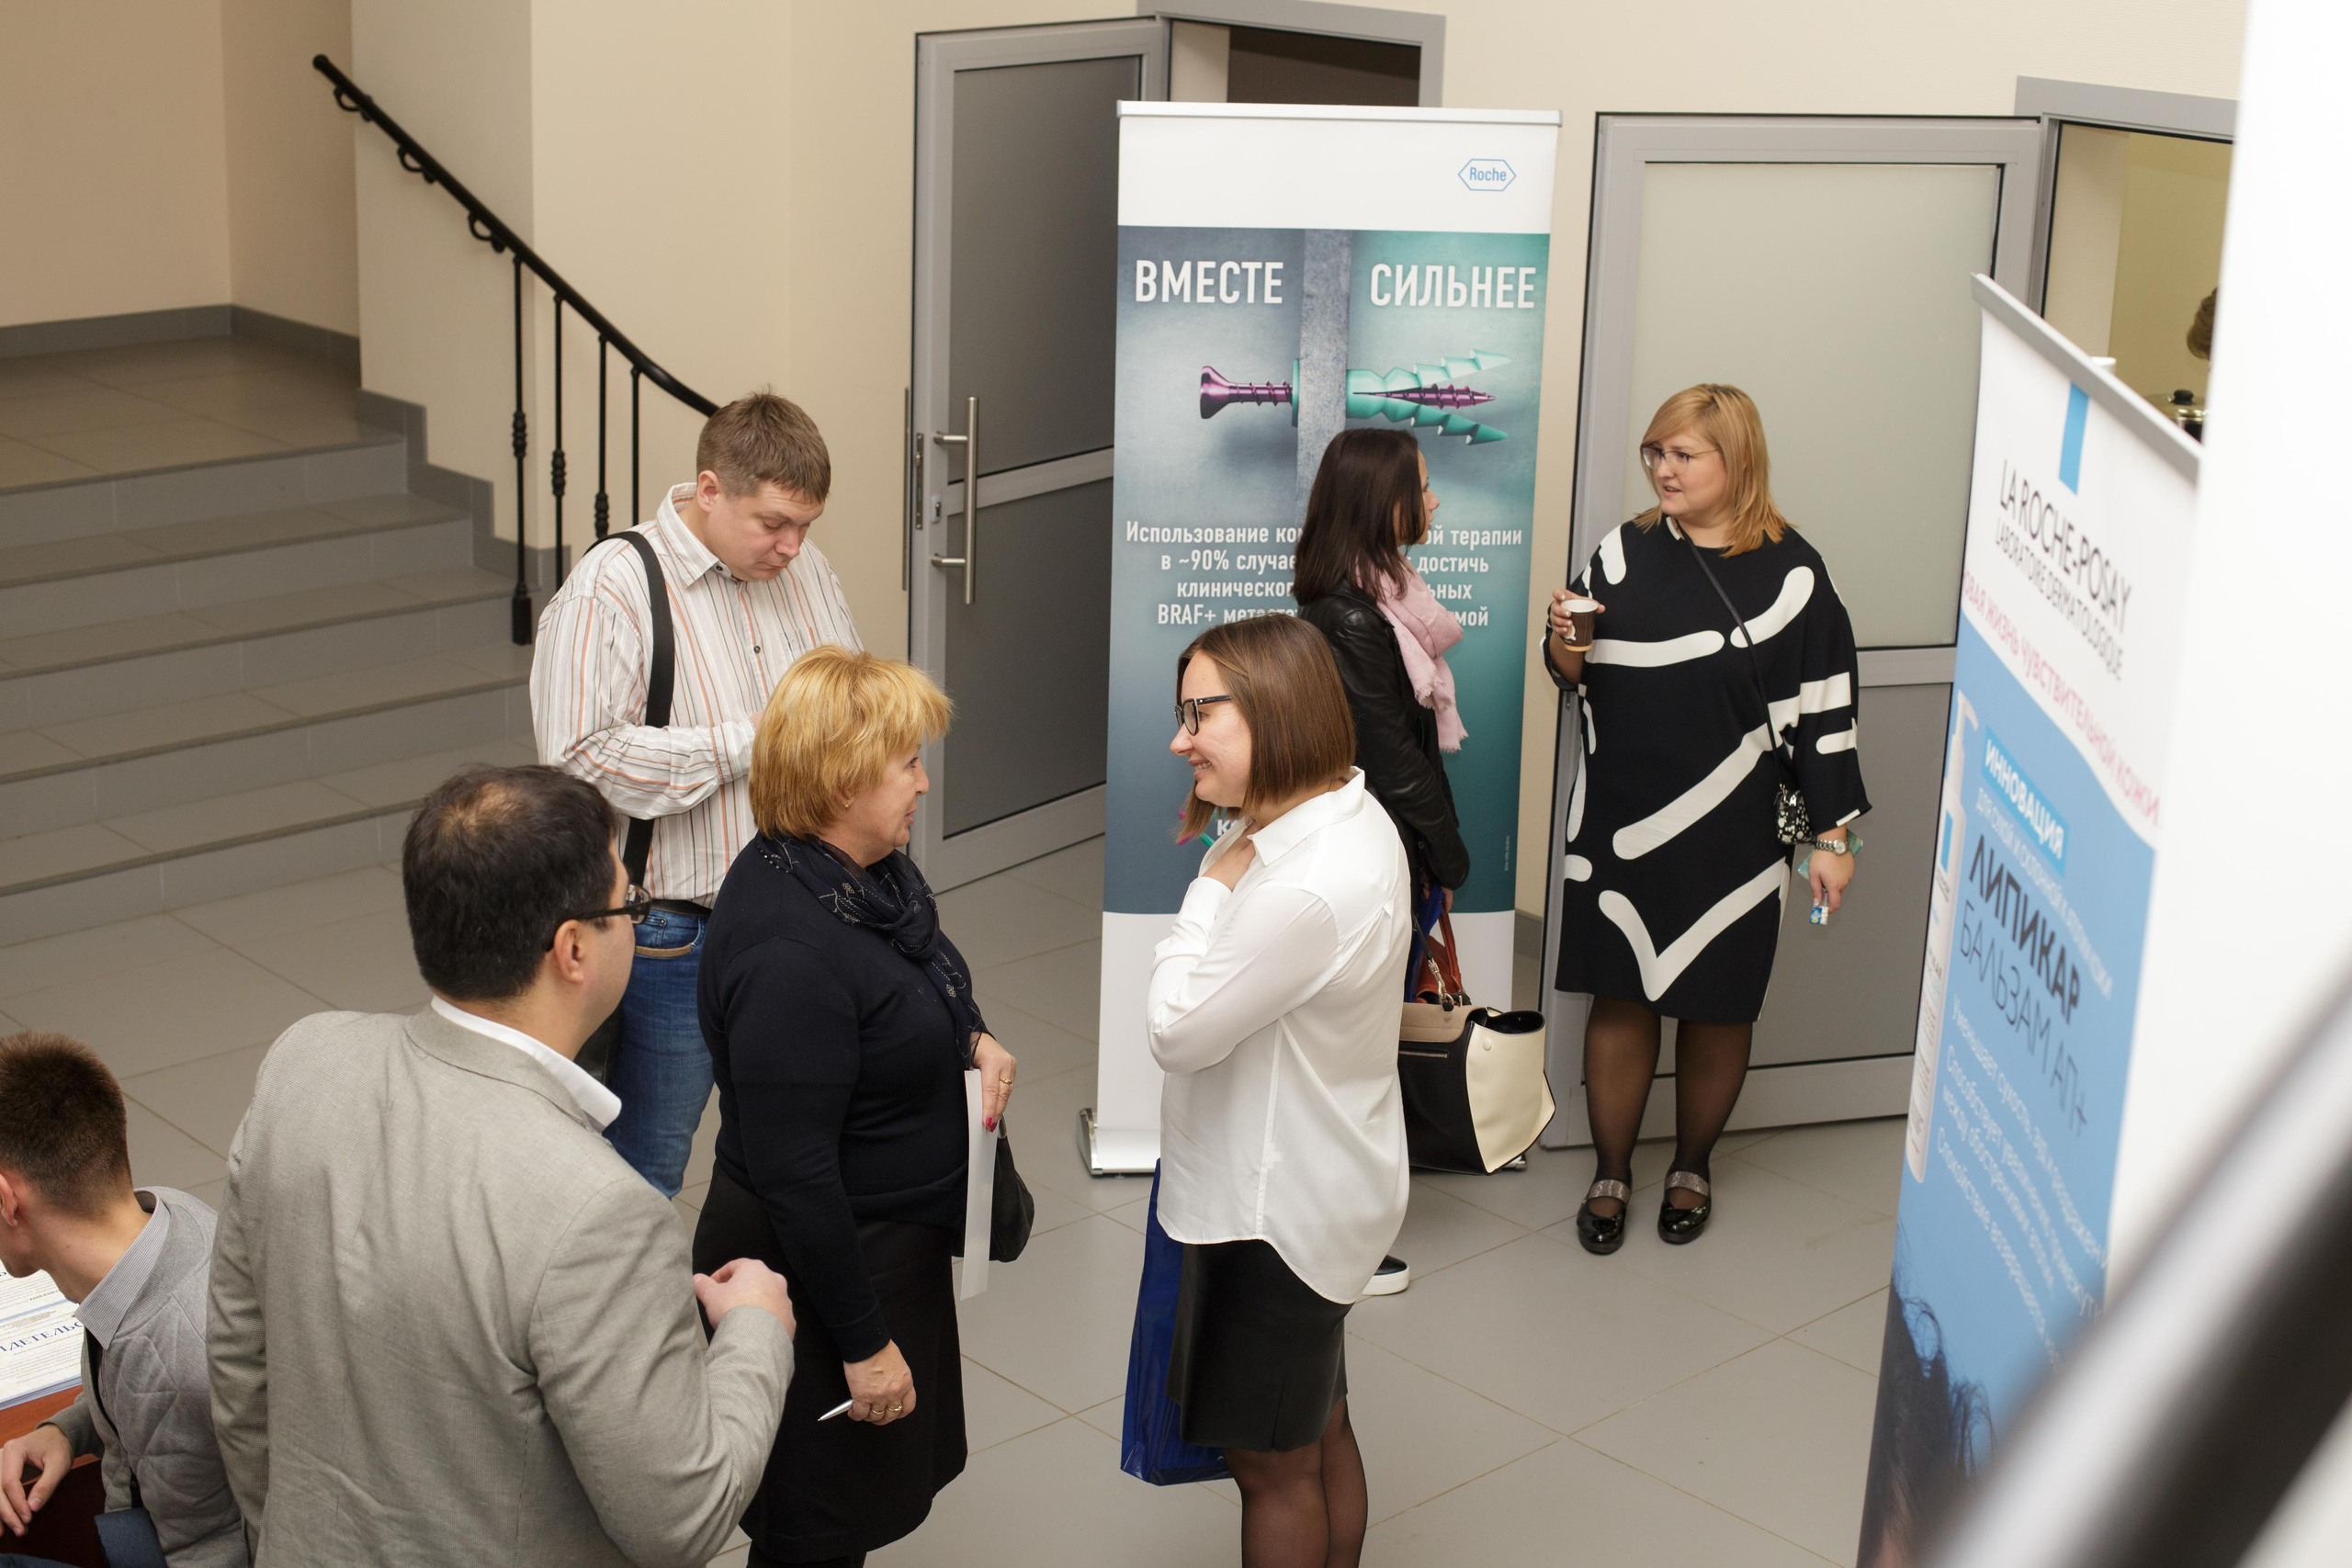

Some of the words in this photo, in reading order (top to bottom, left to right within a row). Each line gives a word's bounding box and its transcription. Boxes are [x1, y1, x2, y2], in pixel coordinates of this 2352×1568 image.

[1469, 166, 1507, 184] Roche
[1135, 260, 1283, 304] ВМЕСТЕ
[1369, 264, 1536, 310] СИЛЬНЕЕ
[1126, 521, 1269, 543] Использование
[1451, 530, 1522, 551] терапии
[2000, 459, 2017, 520] LA
[2018, 478, 2132, 635] ROCHE-POSAY
[1161, 555, 1170, 570] в
[1179, 549, 1229, 570] ~90%
[1417, 557, 1489, 574] достичь
[1158, 604, 1216, 625] BRAF+
[1984, 739, 2064, 861] ИННОВАЦИЯ
[1969, 833, 2081, 1026] ЛИПИКАР
[1960, 899, 2051, 1074] БАЛЬЗАМ
[2050, 1040, 2087, 1137] АП+
